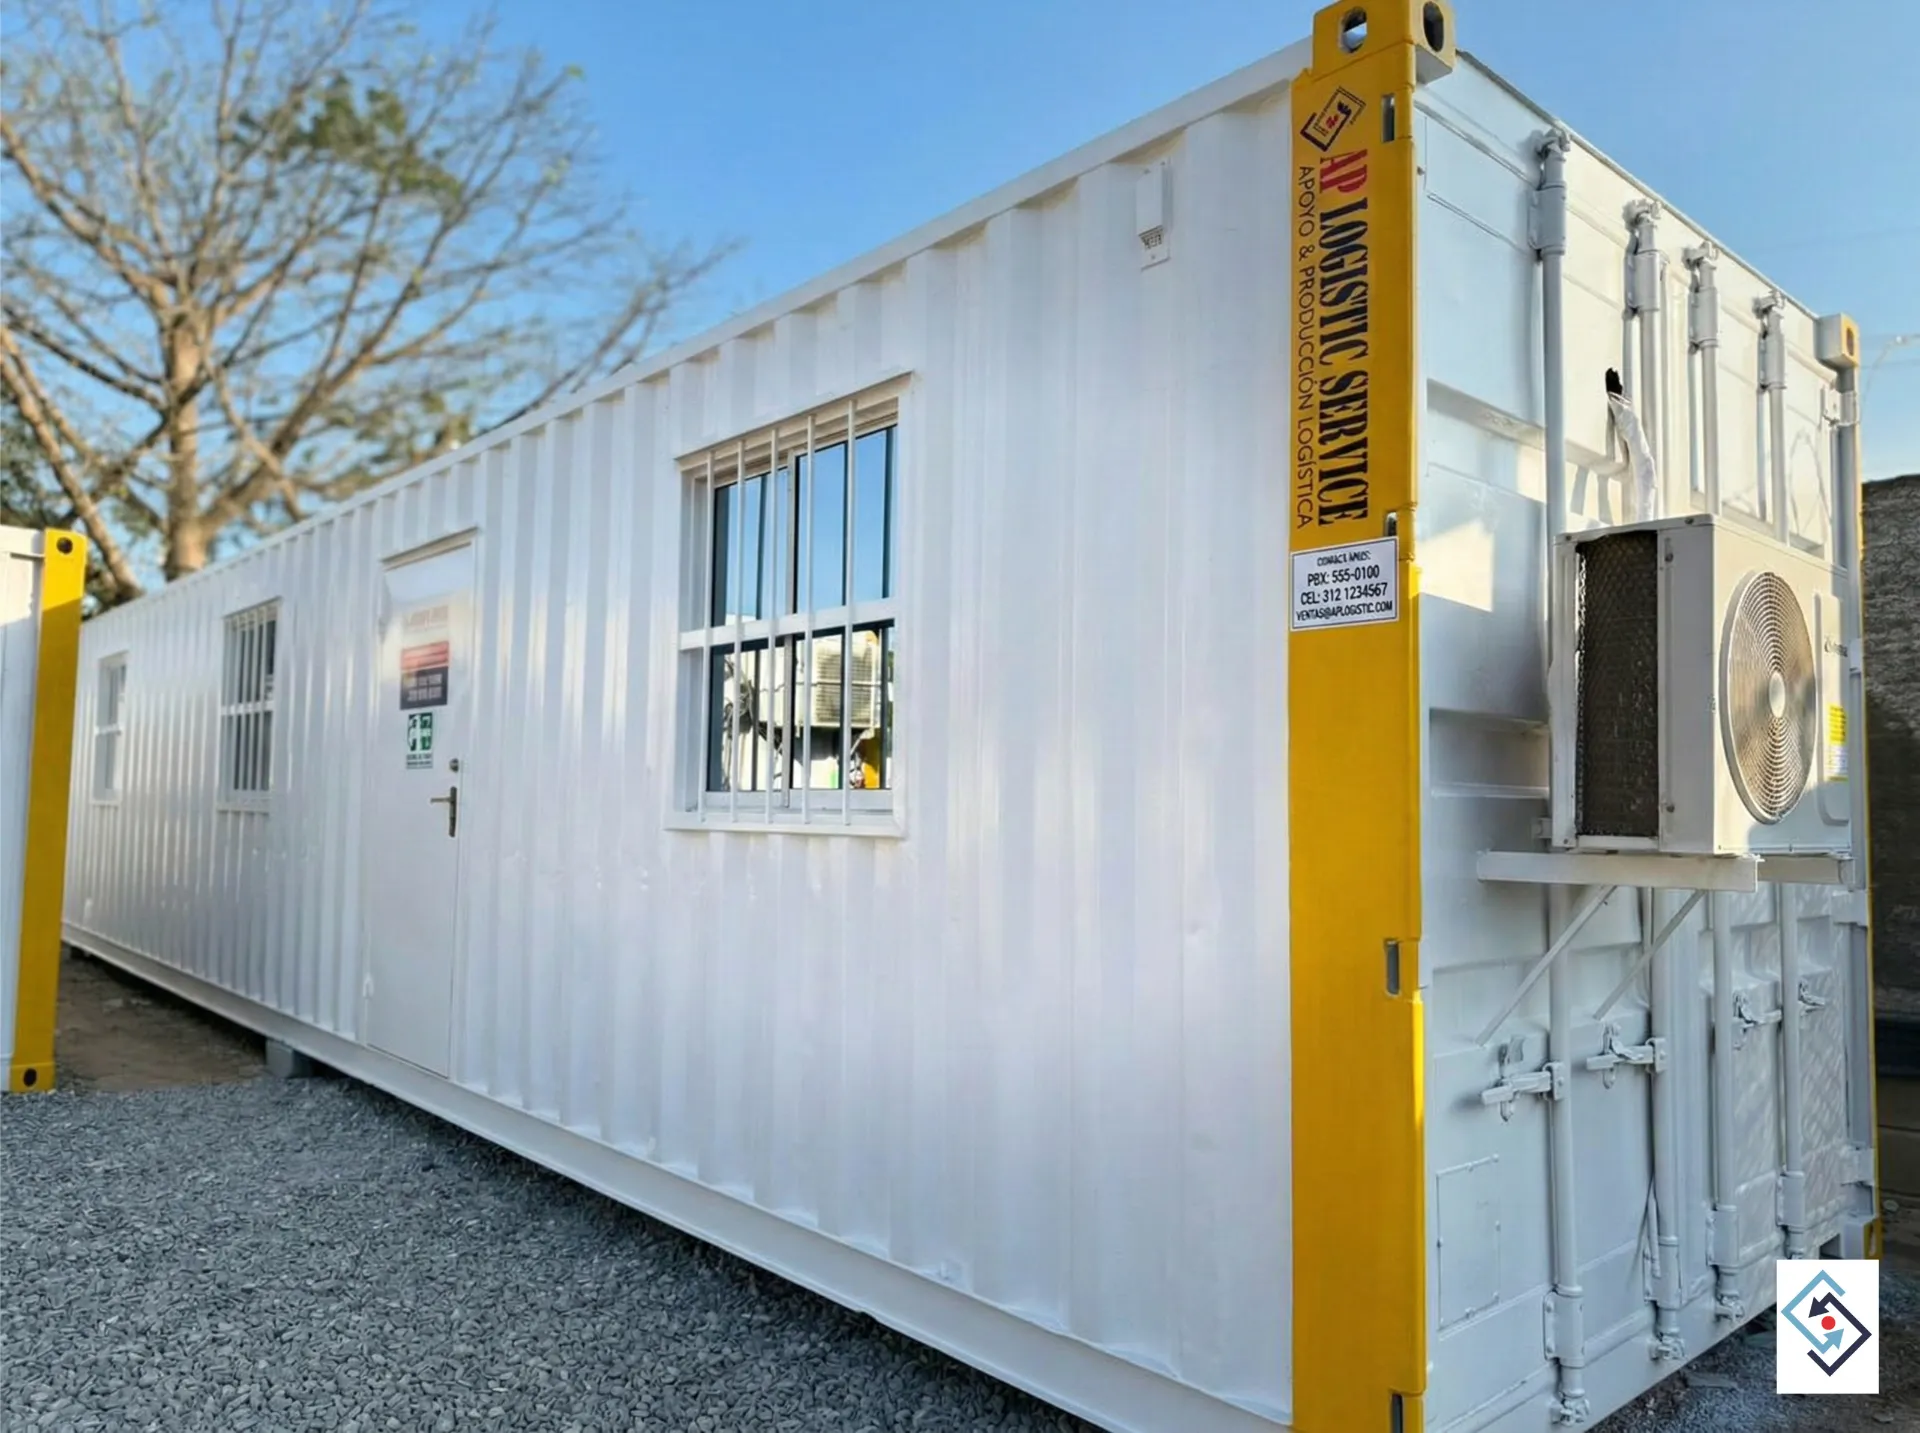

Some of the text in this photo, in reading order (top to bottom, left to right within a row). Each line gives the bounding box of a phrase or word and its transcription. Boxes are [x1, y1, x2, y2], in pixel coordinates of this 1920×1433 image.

[1298, 166, 1315, 237] APOYO
[1298, 245, 1315, 261] &
[1297, 266, 1317, 410] PRODUCCIÓN
[1317, 149, 1369, 526] AP LOGISTIC SERVICE
[1301, 582, 1388, 605] CEL: 312 1234567
[1307, 564, 1380, 586] PBX: 555-0100
